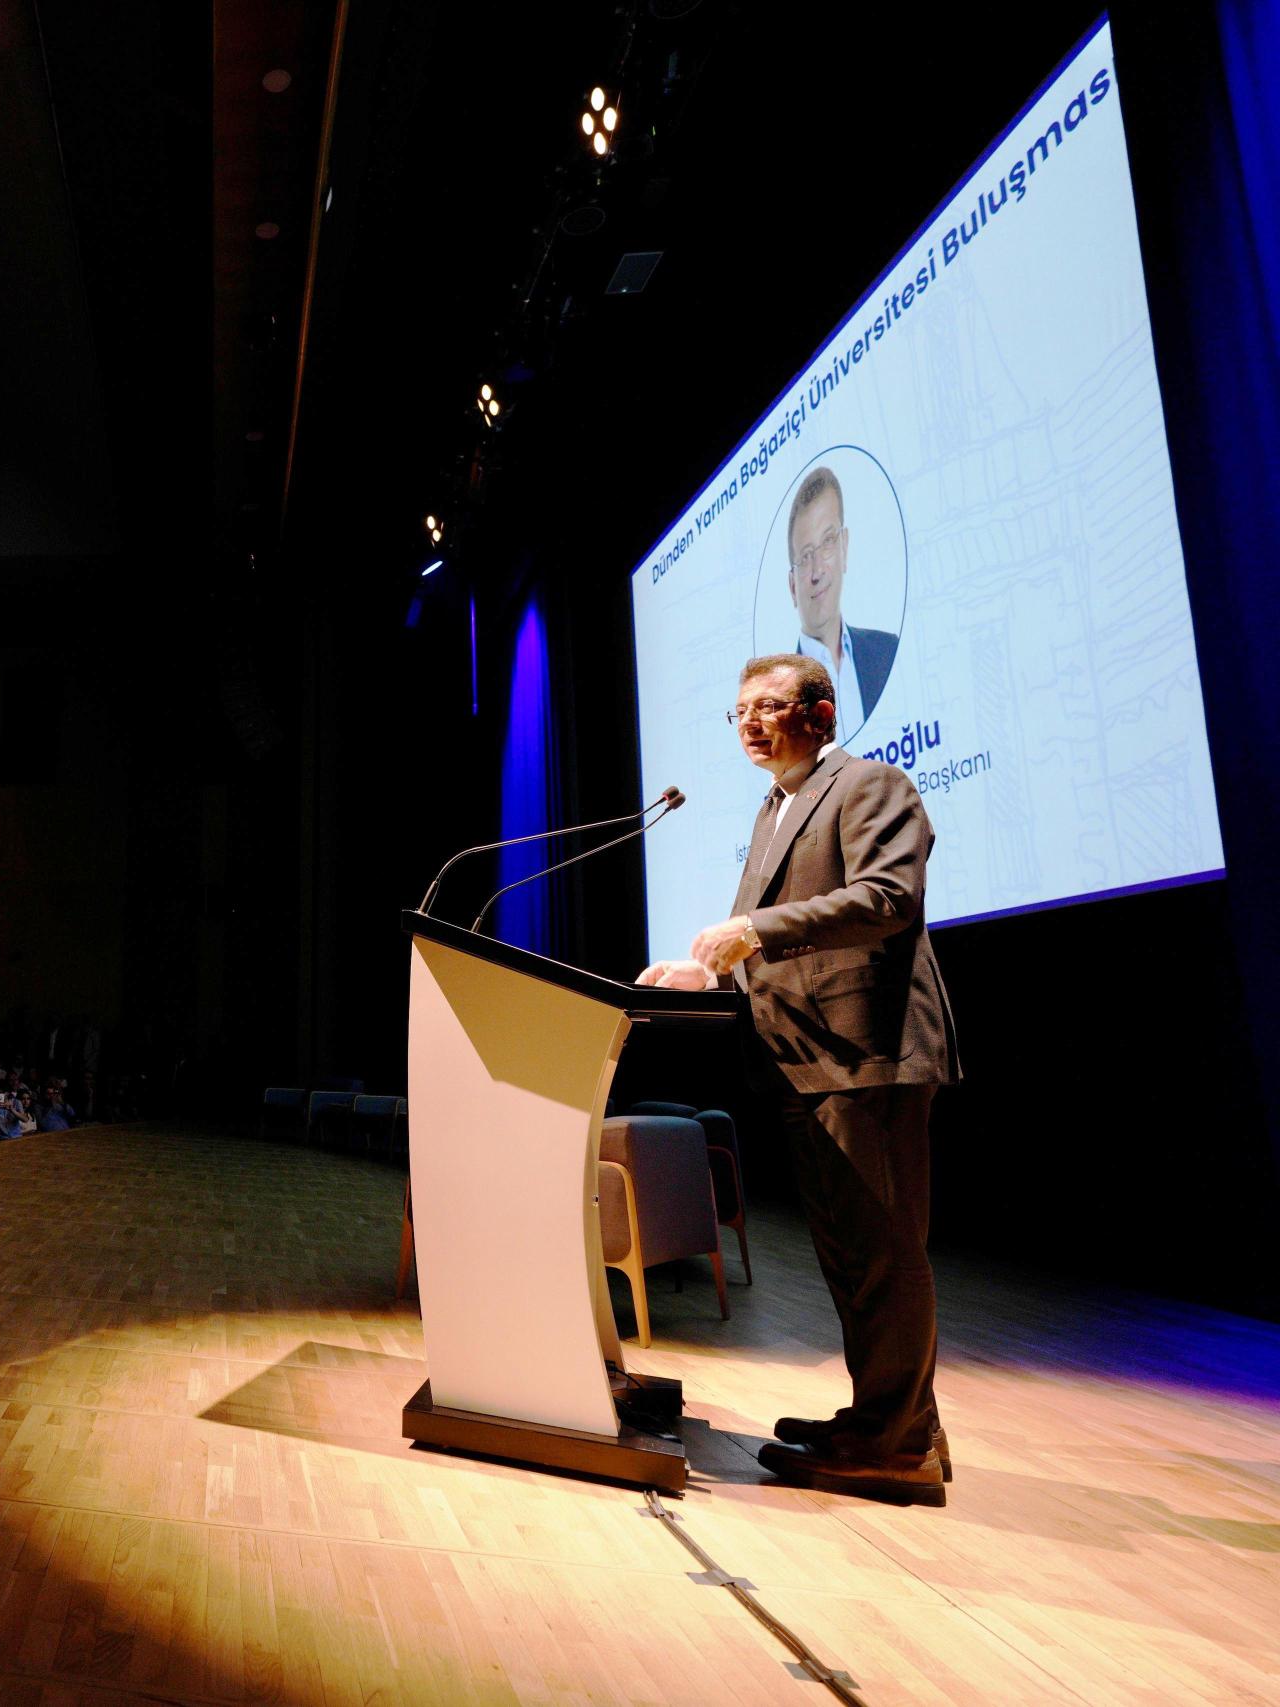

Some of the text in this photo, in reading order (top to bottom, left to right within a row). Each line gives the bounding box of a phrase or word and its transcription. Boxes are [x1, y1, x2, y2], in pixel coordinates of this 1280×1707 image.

[652, 67, 1111, 584] Dünden Yarına Boğaziçi Üniversitesi Buluşmas
[917, 750, 991, 795] Başkanı
